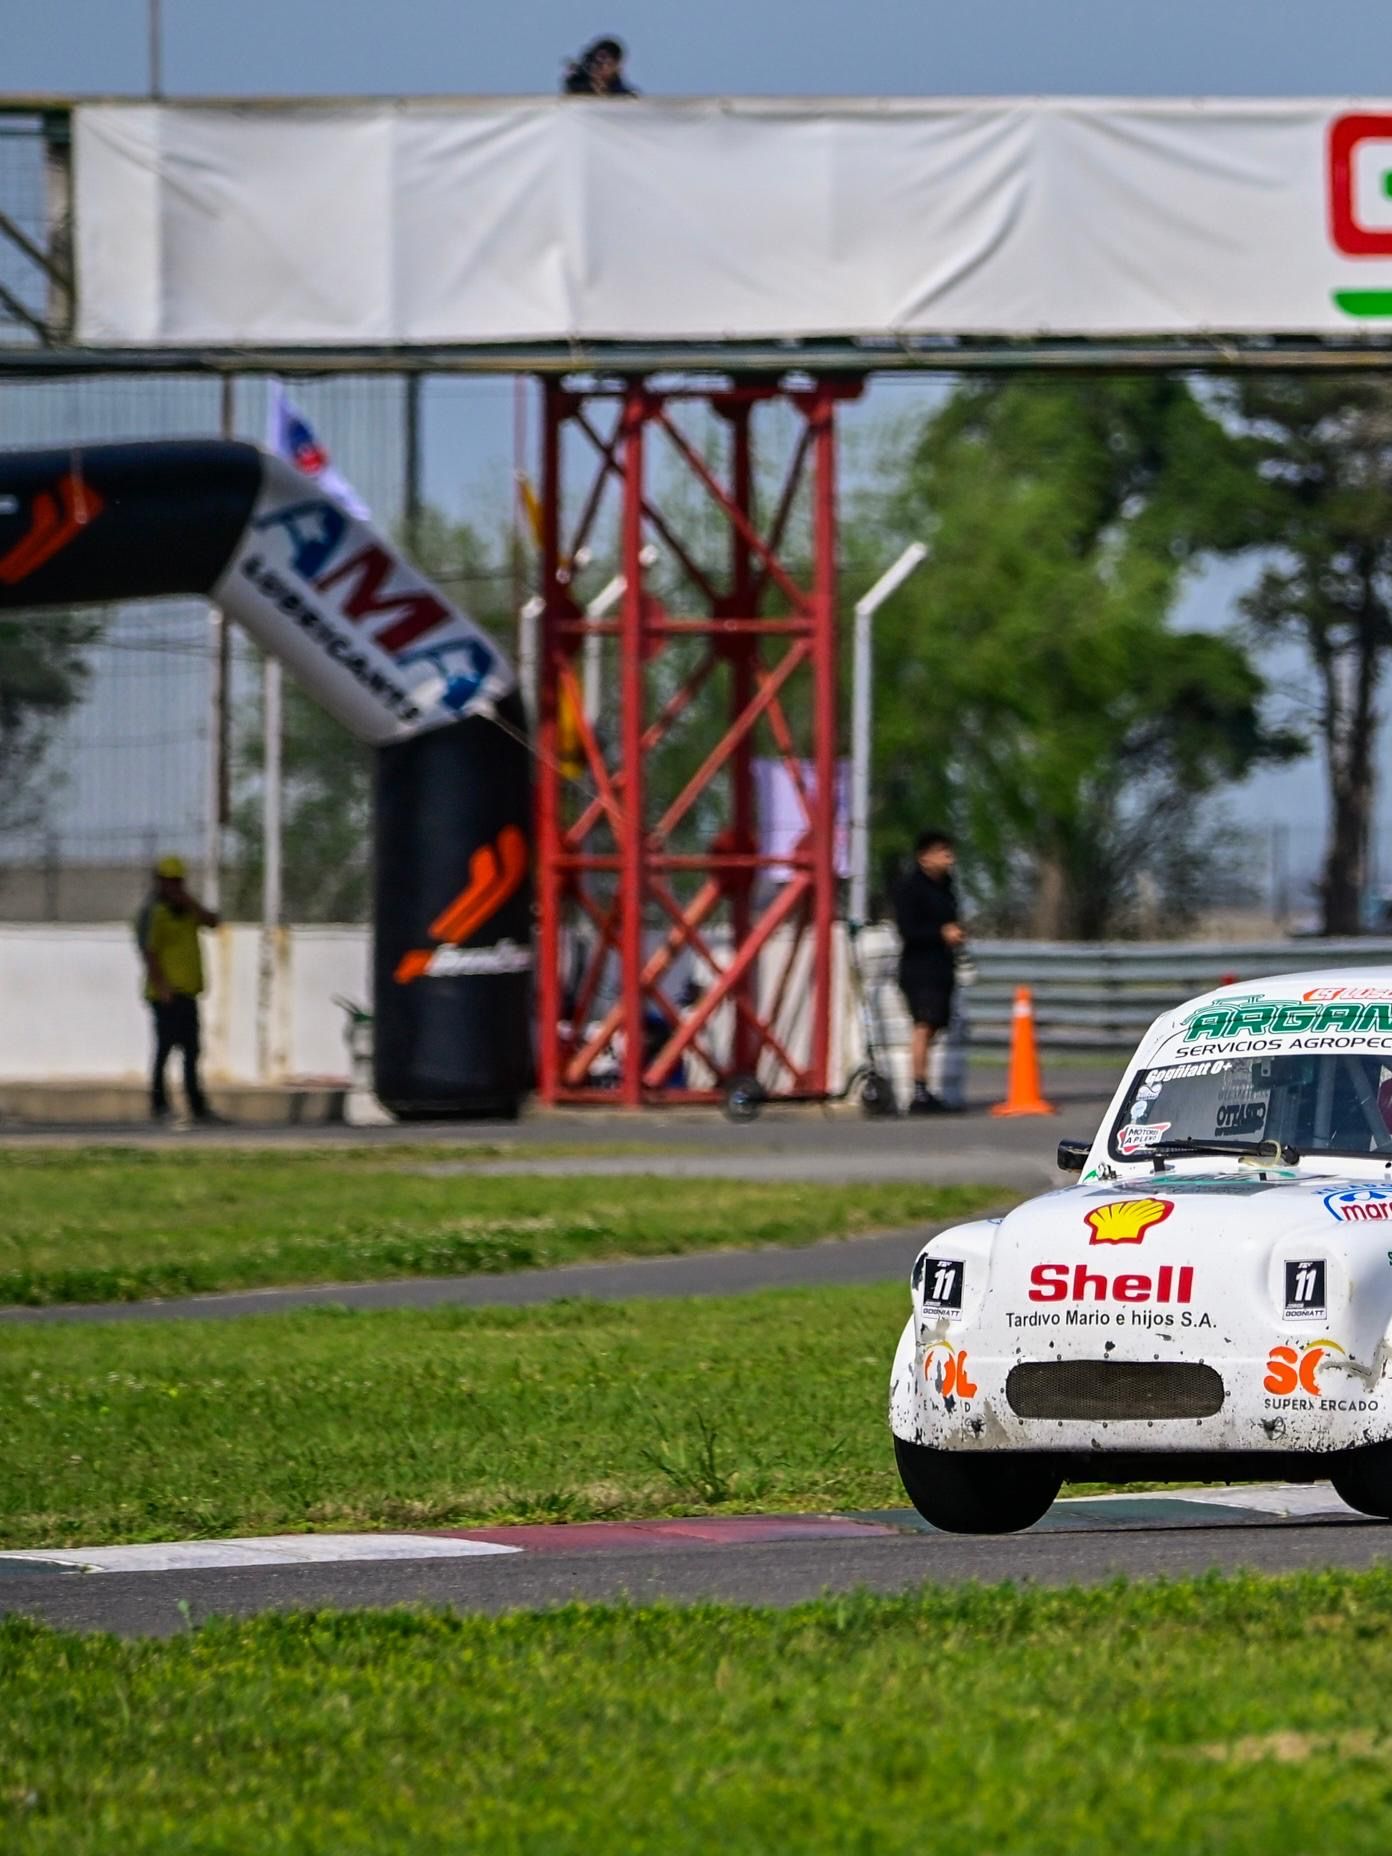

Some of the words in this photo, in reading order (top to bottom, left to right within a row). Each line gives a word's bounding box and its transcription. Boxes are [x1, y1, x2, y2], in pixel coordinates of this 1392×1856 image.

[252, 500, 496, 710] AMA
[242, 555, 421, 720] LUBRICANTS
[1175, 1039, 1283, 1059] SERVICIOS
[932, 1268, 956, 1301] 11
[1028, 1263, 1194, 1304] Shell
[1294, 1269, 1317, 1302] 11
[1006, 1311, 1061, 1328] Tardivo
[1065, 1309, 1110, 1326] Mario
[1115, 1312, 1126, 1326] e
[1131, 1309, 1175, 1330] hijos
[1180, 1311, 1217, 1329] S.A.
